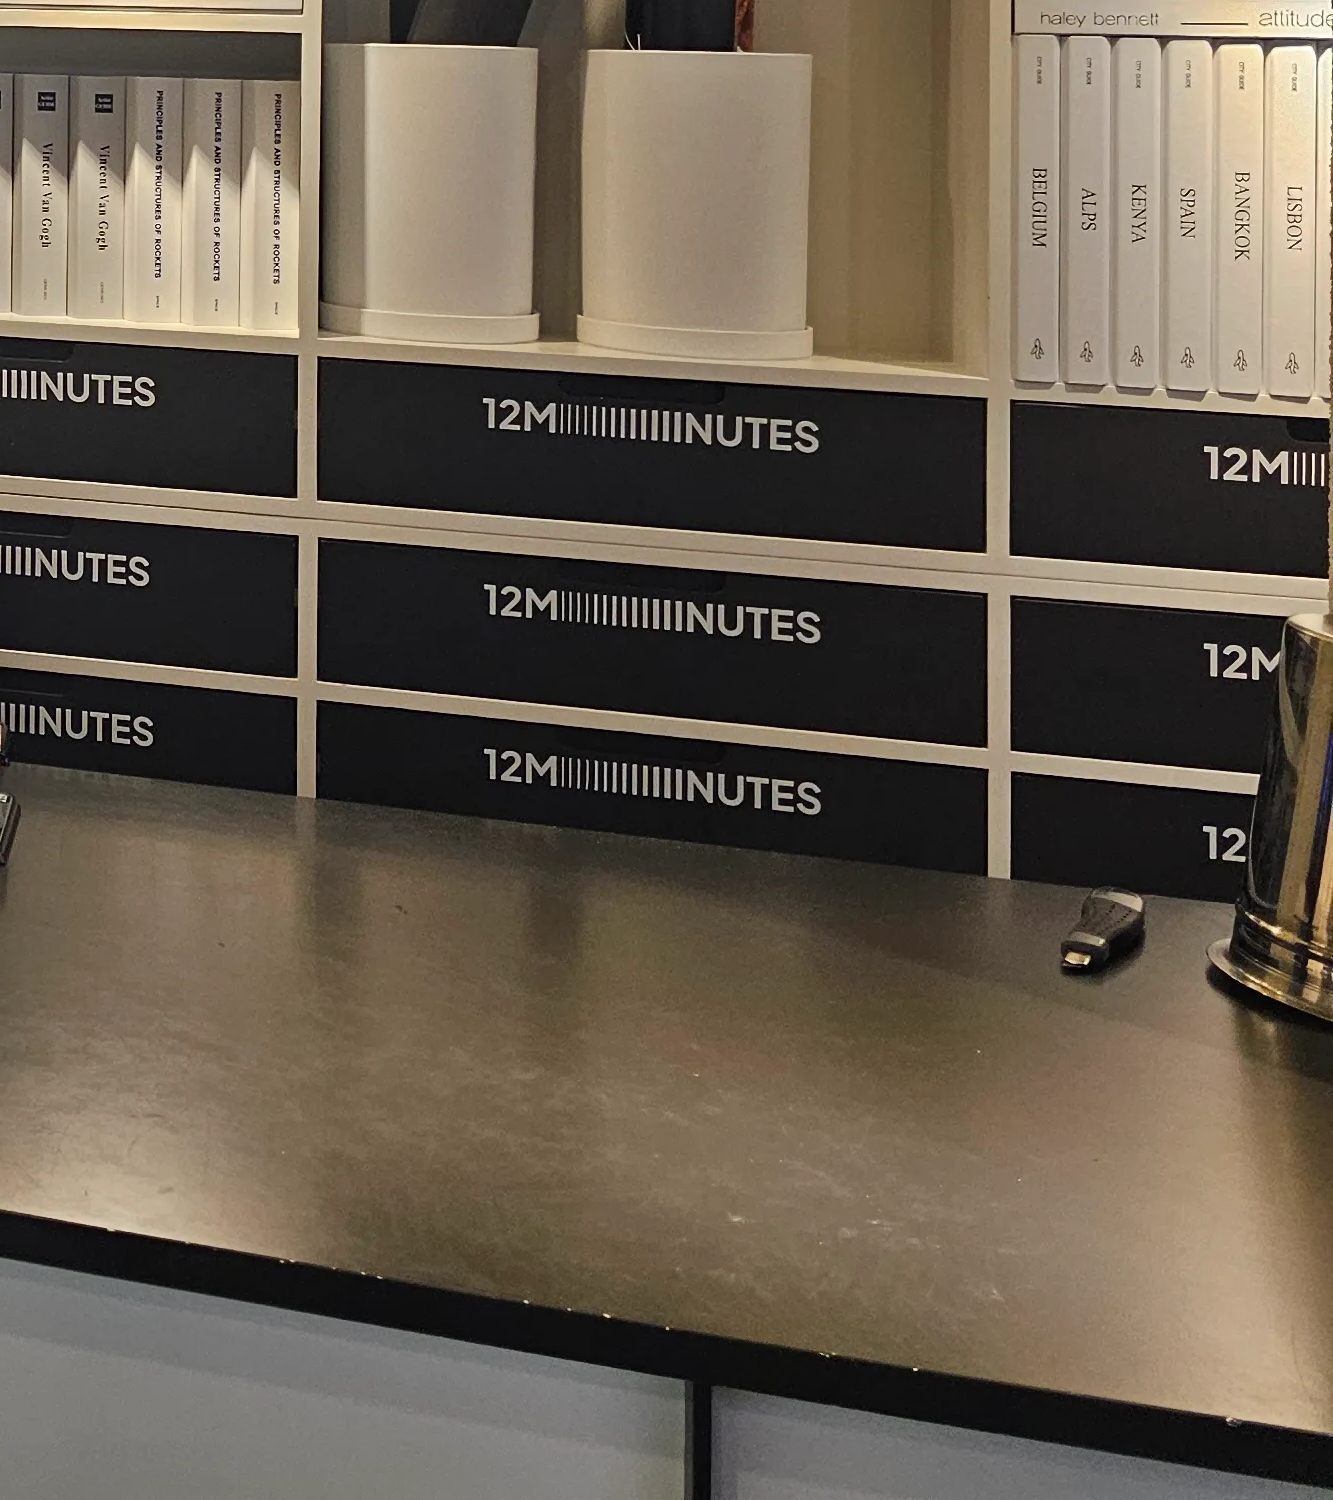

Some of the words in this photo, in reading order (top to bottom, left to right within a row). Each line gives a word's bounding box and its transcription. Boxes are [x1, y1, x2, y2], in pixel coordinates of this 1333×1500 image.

[1041, 12, 1086, 27] haley
[41, 142, 53, 187] Vincent
[99, 145, 110, 189] Vincent
[42, 193, 52, 212] Van
[99, 195, 109, 215] Van
[1032, 168, 1047, 247] BELGIUM
[1082, 188, 1096, 230] ALPS
[1132, 185, 1146, 242] KENYA
[1180, 189, 1195, 238] SPAIN
[1235, 172, 1250, 260] BANGKOK
[1287, 187, 1302, 250] LISBON
[40, 218, 51, 247] Gogh
[96, 221, 108, 250] Gogh
[155, 224, 161, 235] OF
